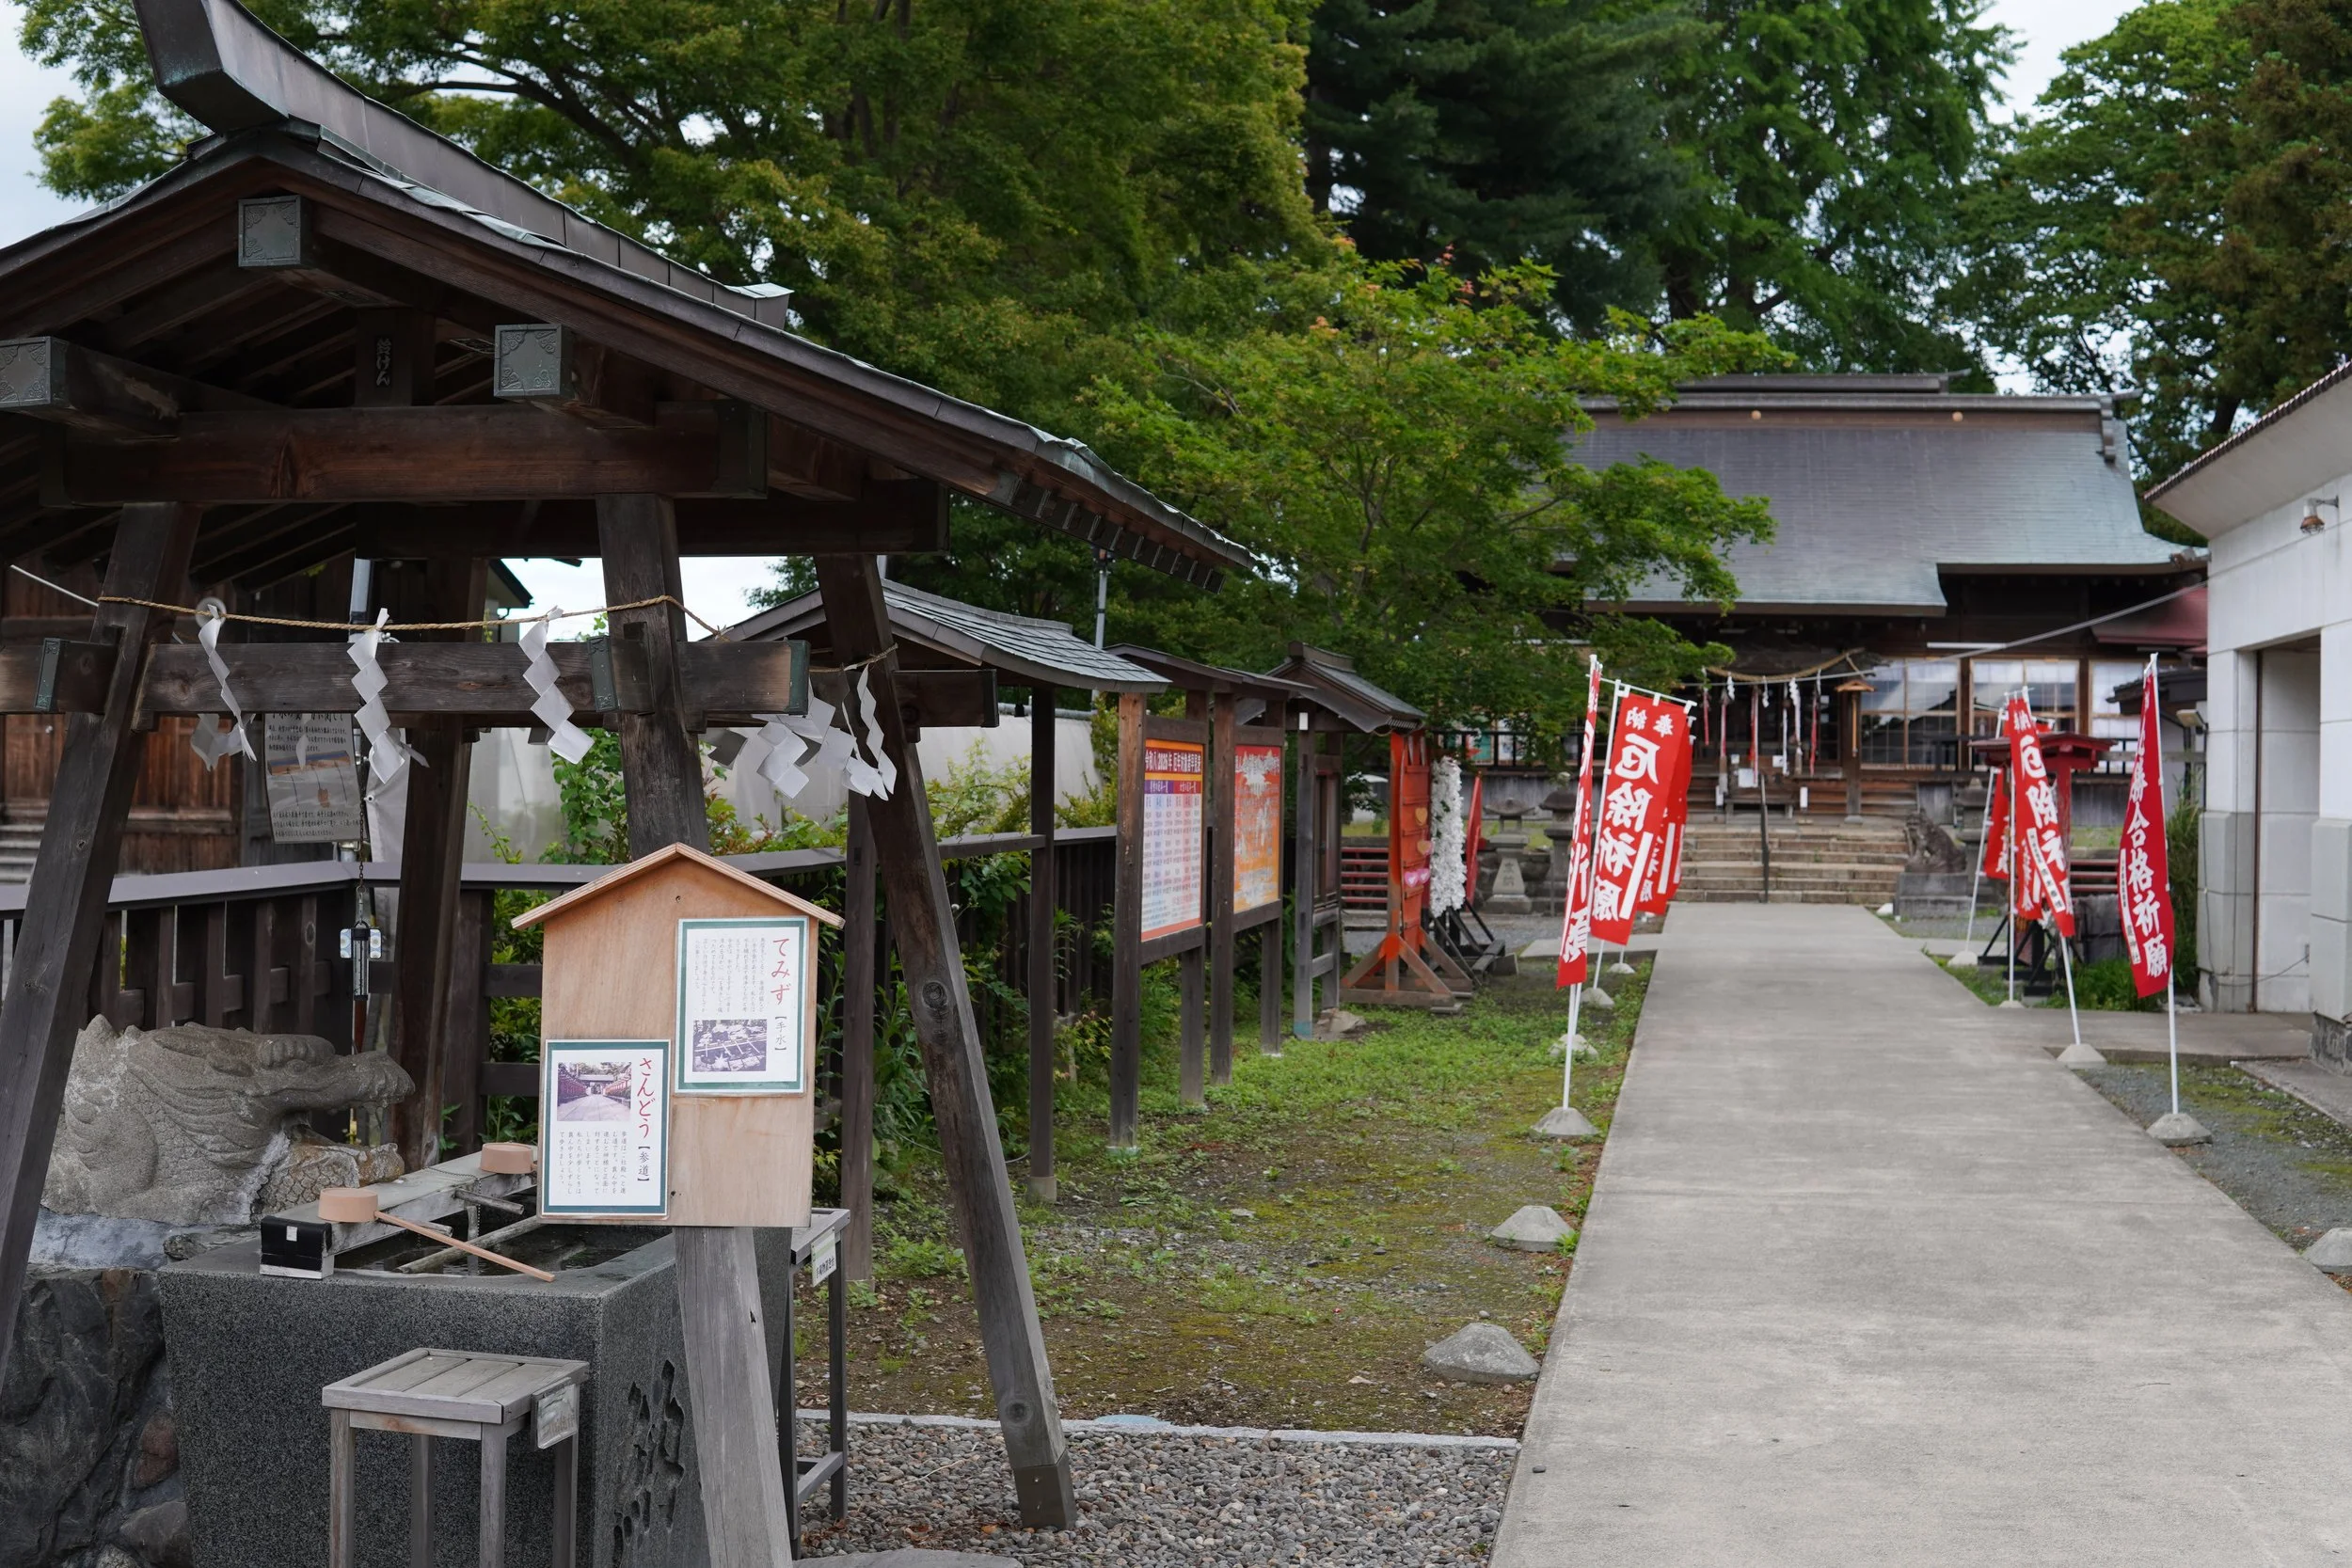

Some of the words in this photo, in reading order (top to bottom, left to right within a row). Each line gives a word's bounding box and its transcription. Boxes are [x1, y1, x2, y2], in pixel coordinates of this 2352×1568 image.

[771, 938, 792, 1006] てみず
[773, 1015, 787, 1053] 【手水】
[637, 1057, 656, 1139] さんどう
[637, 1145, 651, 1182] 【参道】
